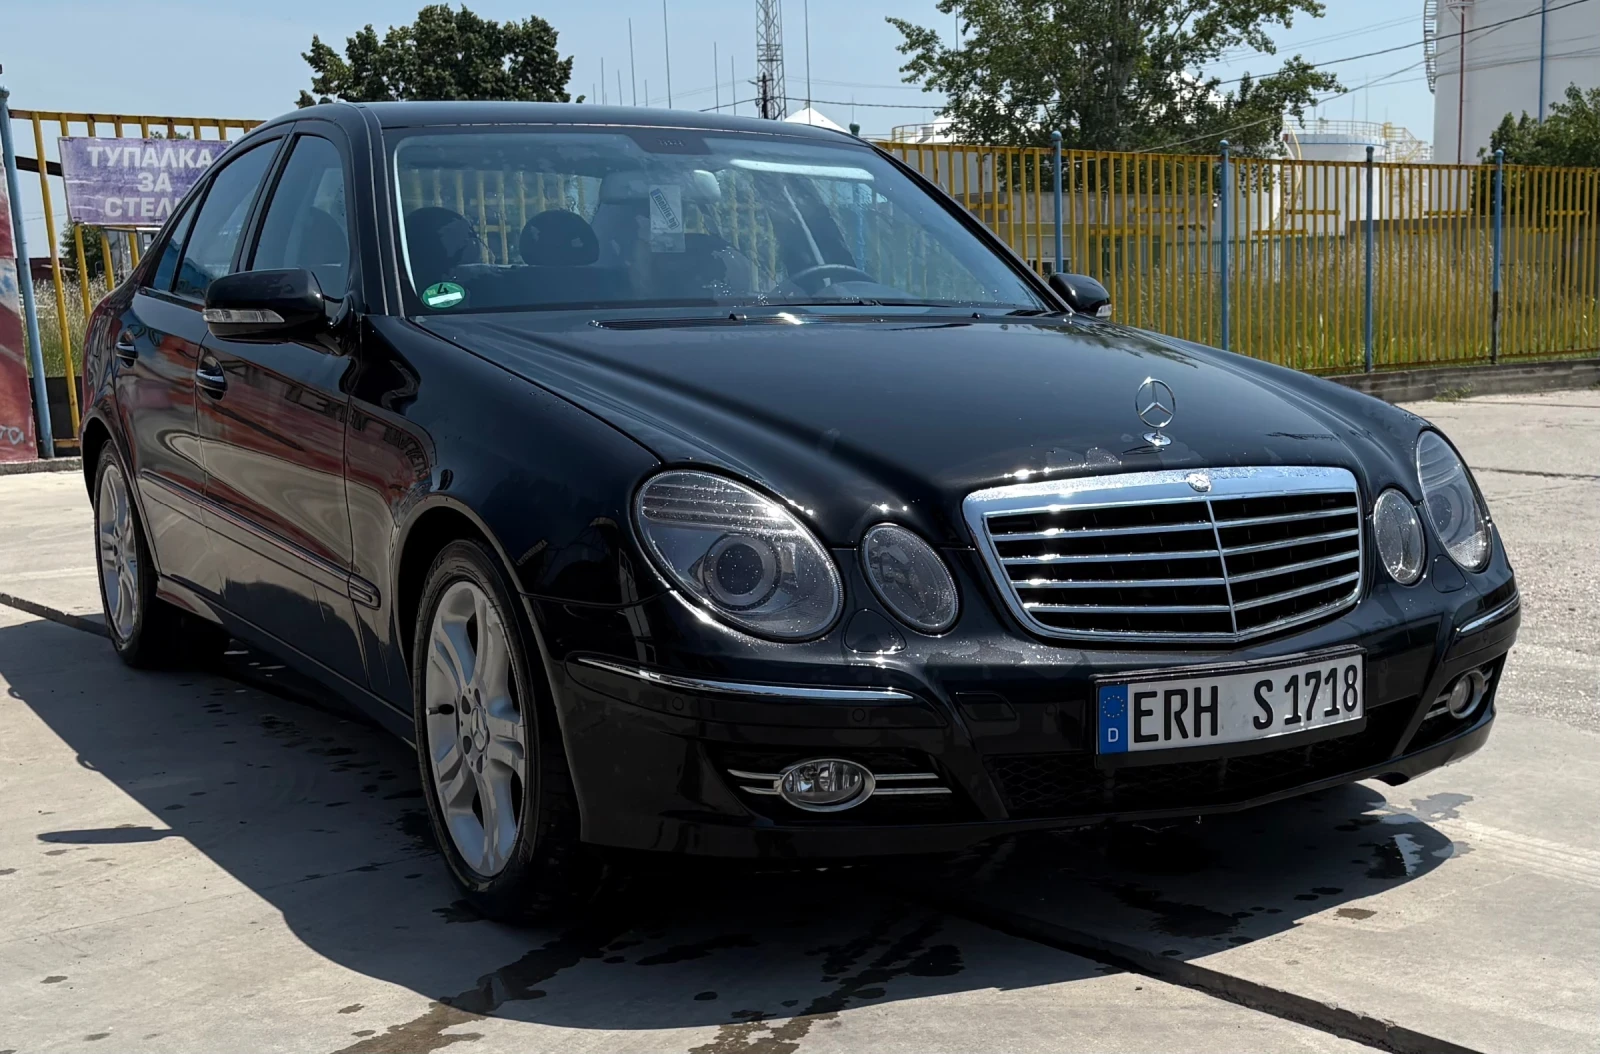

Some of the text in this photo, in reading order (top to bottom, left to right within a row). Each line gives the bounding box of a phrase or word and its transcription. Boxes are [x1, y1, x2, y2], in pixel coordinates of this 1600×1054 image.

[87, 147, 213, 168] ТУПАЛКА
[137, 172, 172, 193] ЗА
[1133, 685, 1219, 743] ERH
[1108, 727, 1119, 743] D
